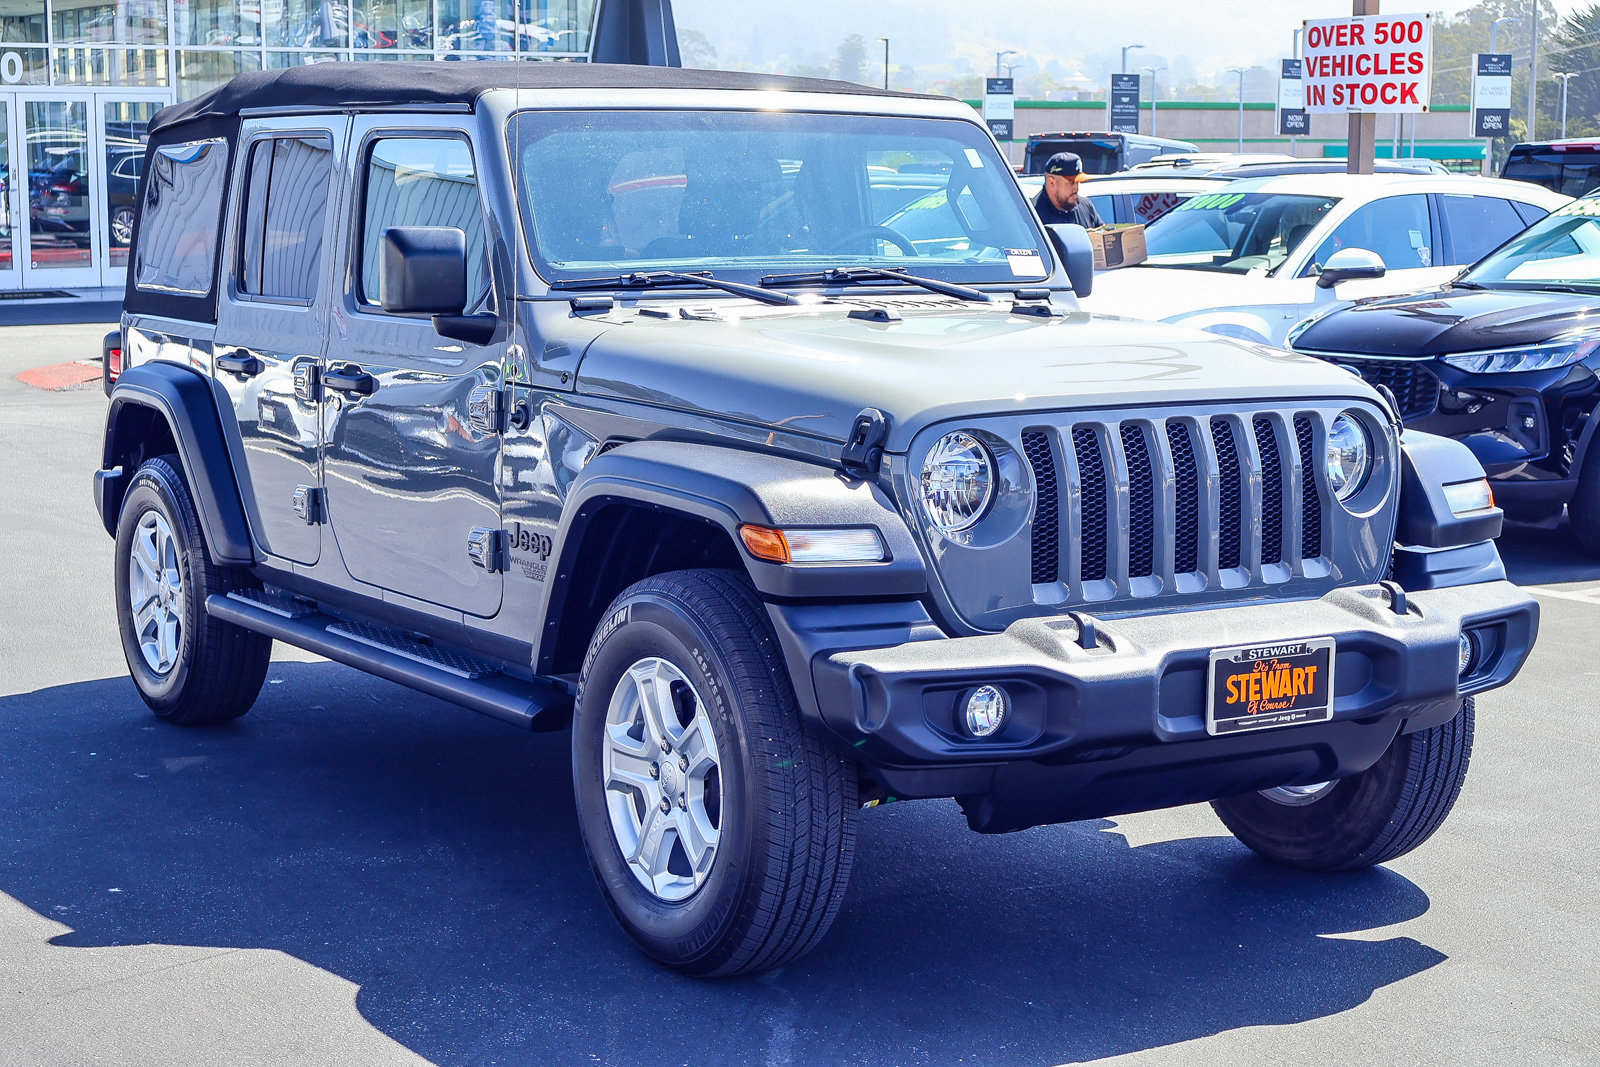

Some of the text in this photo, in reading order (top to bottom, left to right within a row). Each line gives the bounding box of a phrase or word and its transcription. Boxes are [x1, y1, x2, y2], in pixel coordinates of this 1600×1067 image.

[1308, 21, 1423, 48] OVER 500
[1305, 52, 1424, 77] VEHICLES
[1306, 82, 1419, 106] IN STOCK
[1482, 122, 1503, 130] OPEN
[508, 522, 552, 561] Jeep
[583, 606, 628, 679] MICHELIN
[1248, 645, 1302, 660] STEWART
[1252, 658, 1291, 673] It's From
[1226, 665, 1318, 705] STEWART
[1247, 700, 1259, 715] Of
